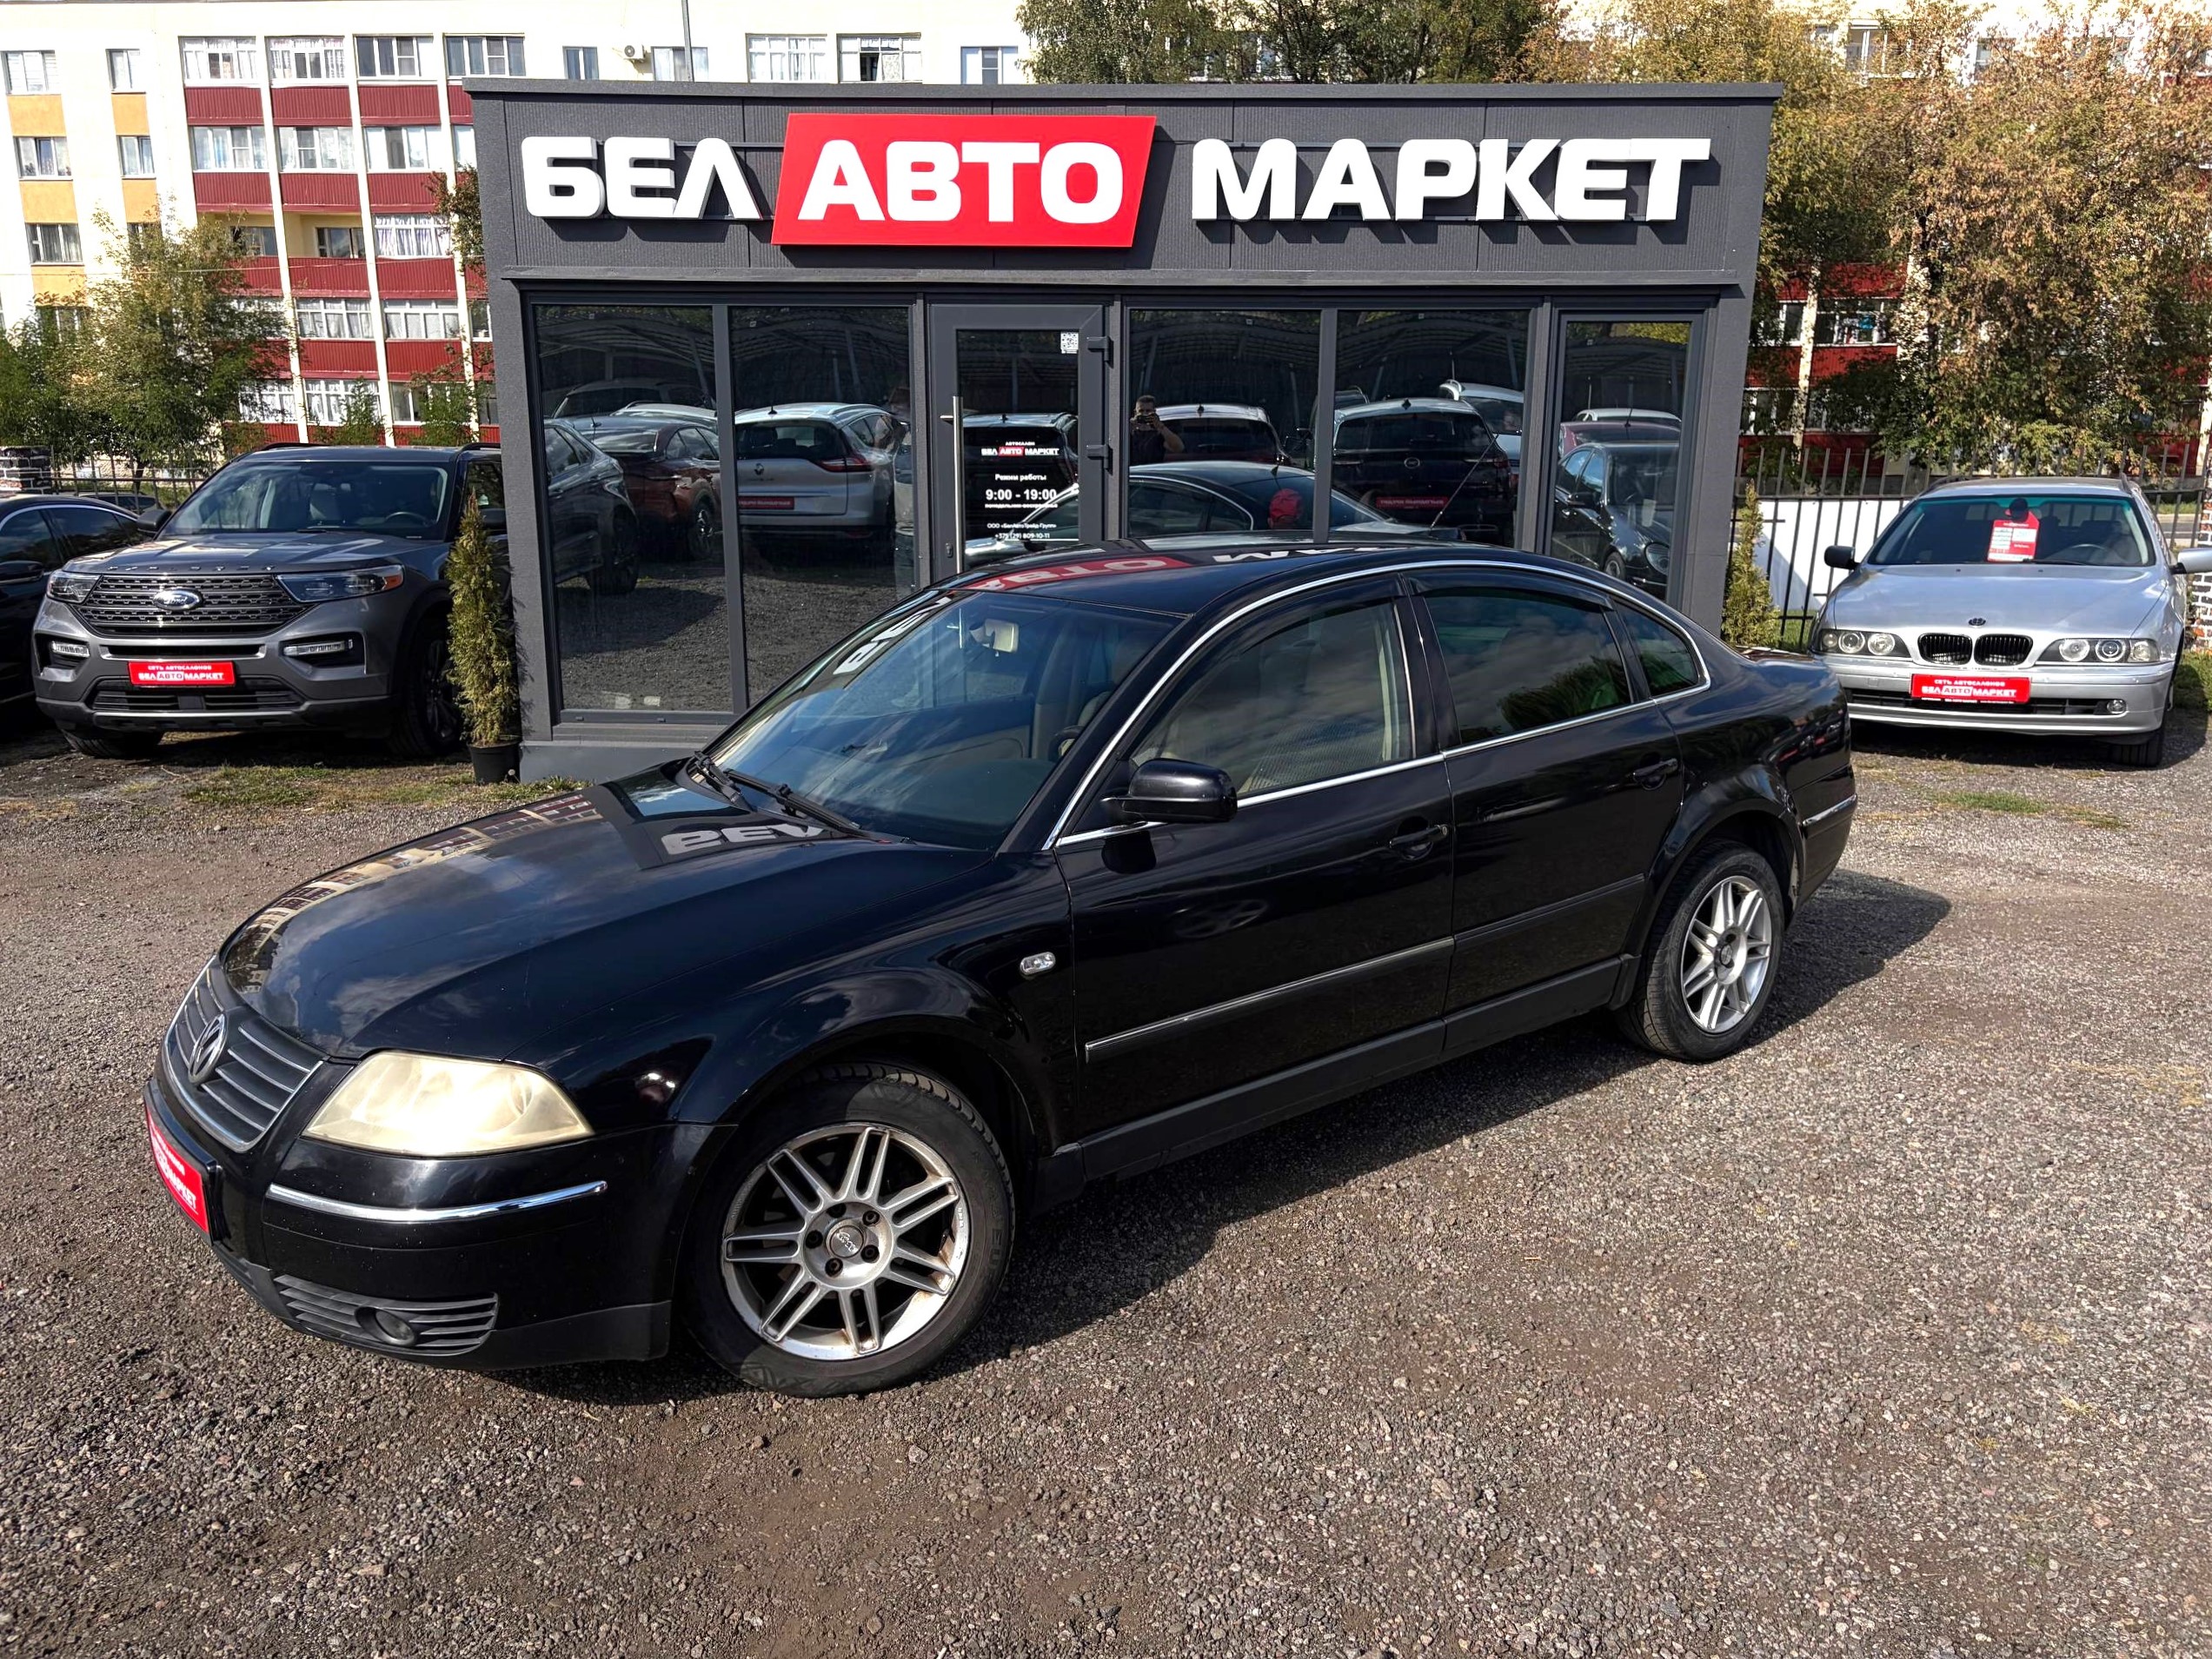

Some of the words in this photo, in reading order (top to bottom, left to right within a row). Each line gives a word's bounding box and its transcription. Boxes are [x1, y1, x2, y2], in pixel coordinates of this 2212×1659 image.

[521, 135, 763, 220] БЕЛ
[797, 139, 1124, 224] АВТО
[1192, 137, 1712, 222] МАРКЕТ
[986, 489, 1012, 501] 9:00
[1023, 488, 1057, 501] 19:00
[183, 673, 225, 681] МАРКЕТ
[1921, 686, 1941, 694] БЕЛ
[1972, 688, 2017, 697] МАРКЕТ
